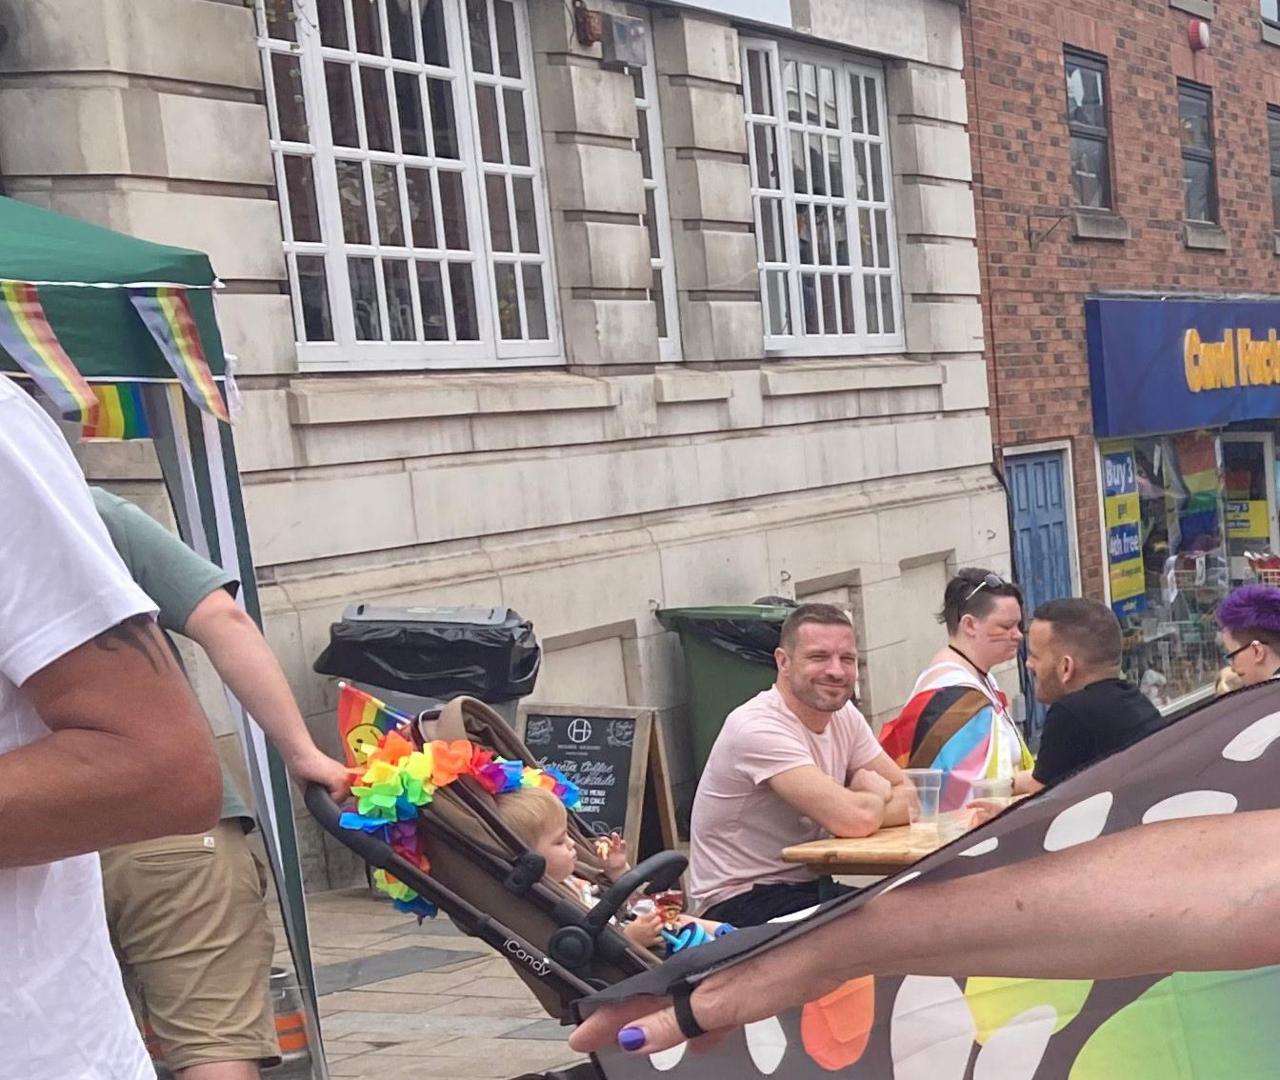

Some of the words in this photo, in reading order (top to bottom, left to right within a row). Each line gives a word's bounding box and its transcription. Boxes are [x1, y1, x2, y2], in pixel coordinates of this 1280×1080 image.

[1184, 328, 1236, 392] Card
[1105, 459, 1126, 493] Buy
[1126, 456, 1134, 485] 3
[1123, 530, 1140, 551] free
[503, 937, 551, 976] iCandy
